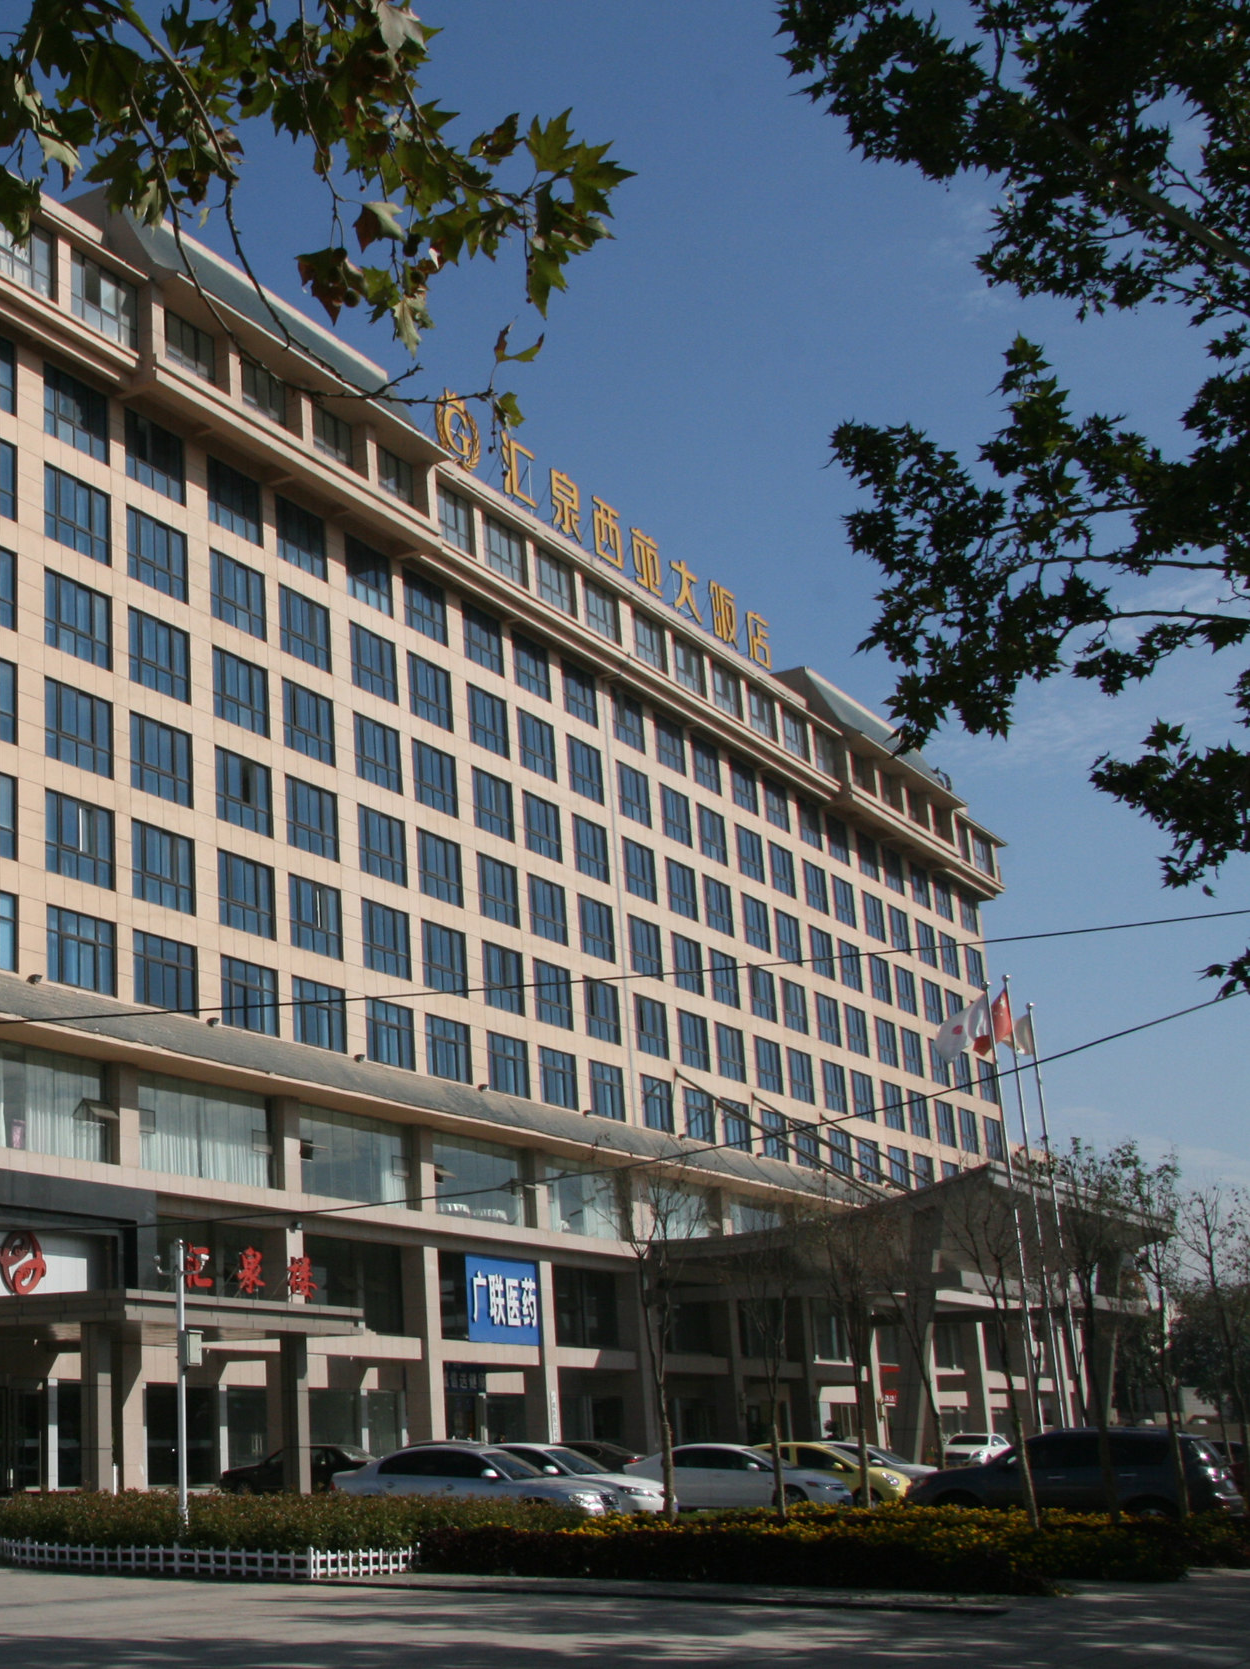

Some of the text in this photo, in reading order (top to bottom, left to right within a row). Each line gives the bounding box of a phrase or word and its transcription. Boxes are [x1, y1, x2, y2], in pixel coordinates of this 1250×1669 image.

[500, 430, 772, 671] 汇泉西亚大饭店
[472, 1270, 537, 1327] 广联医药
